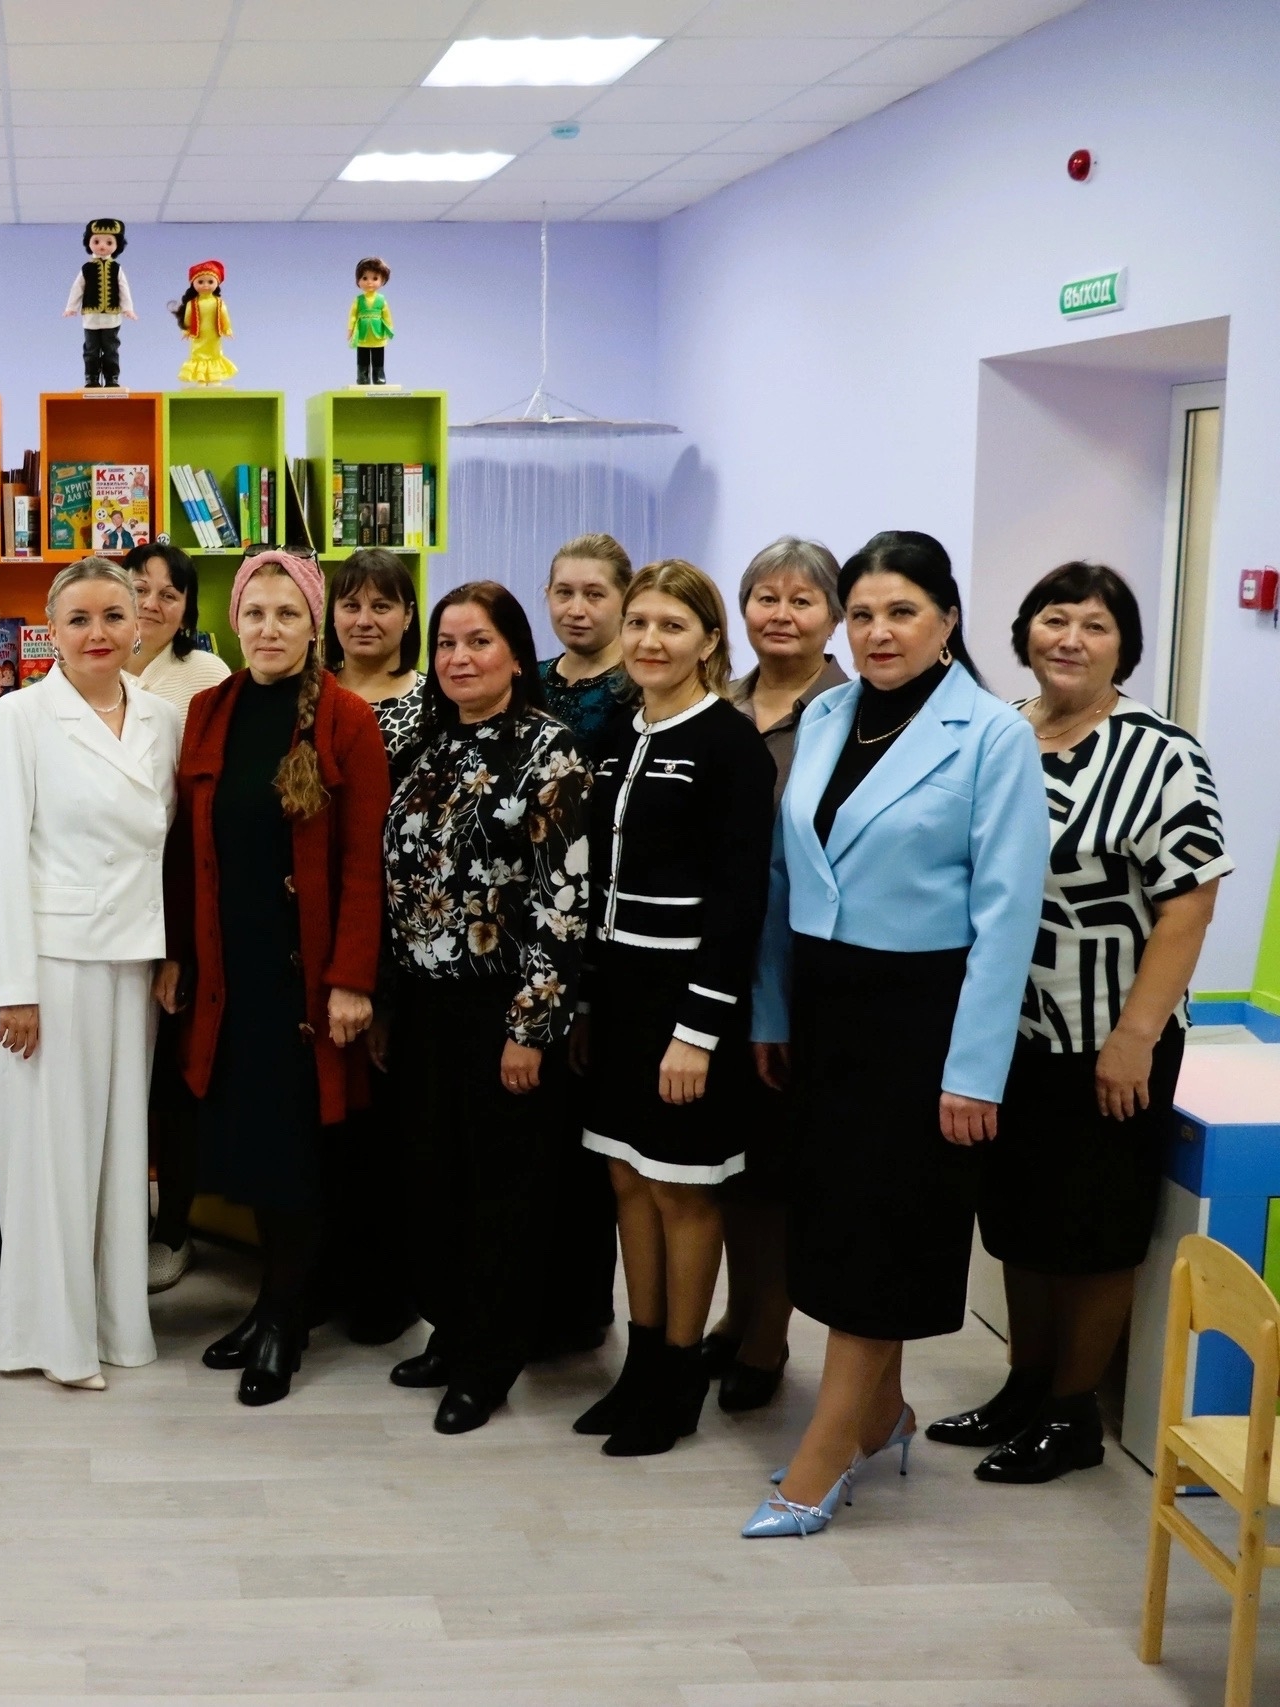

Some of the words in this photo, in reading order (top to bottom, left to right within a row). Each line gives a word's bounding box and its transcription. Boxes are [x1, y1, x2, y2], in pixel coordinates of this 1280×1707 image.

[1063, 278, 1112, 310] ВЫХОД
[65, 481, 92, 495] КРИПТ
[67, 492, 82, 503] ДЛЯ
